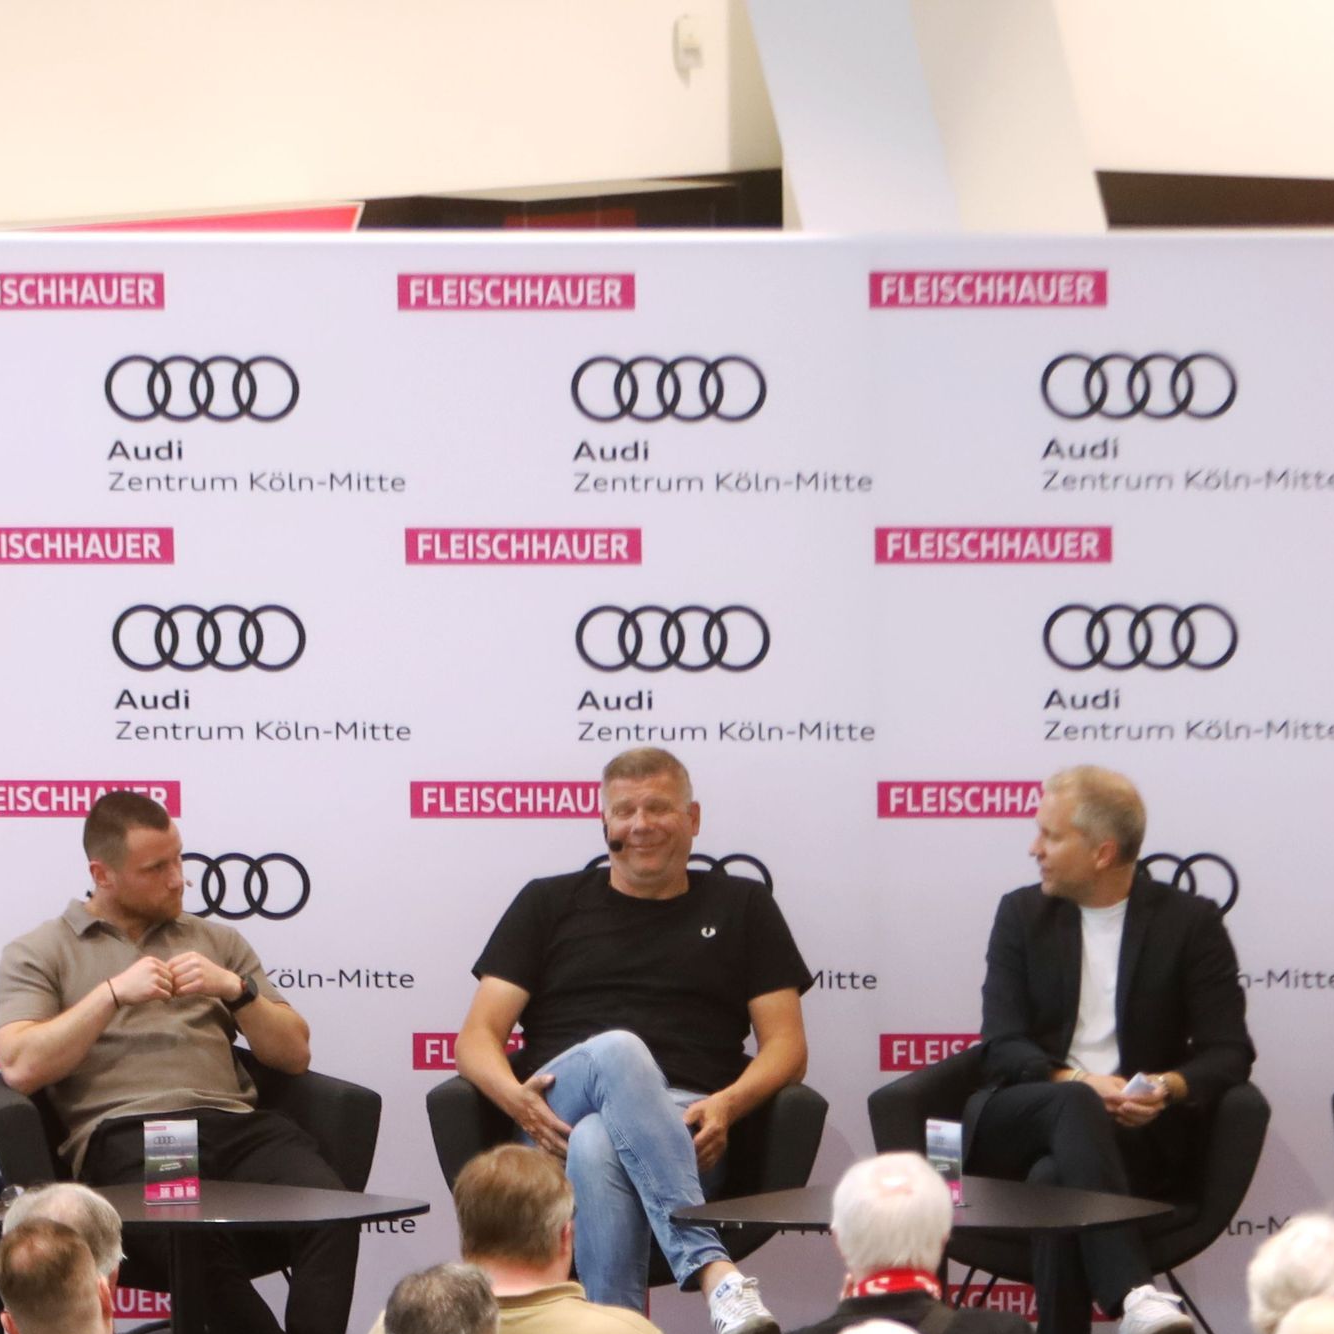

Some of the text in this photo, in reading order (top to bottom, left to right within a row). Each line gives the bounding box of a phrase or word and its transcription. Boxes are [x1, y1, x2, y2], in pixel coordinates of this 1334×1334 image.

[410, 279, 622, 305] FLEISCHHAUER
[881, 276, 1094, 303] FLEISCHHAUER
[108, 440, 183, 461] Audi
[574, 441, 649, 461] Audi
[1043, 438, 1118, 459] Audi
[109, 471, 406, 492] Zentrum Köln-Mitte
[574, 472, 873, 492] Zentrum Köln-Mitte
[1043, 469, 1174, 491] Zentrum
[417, 533, 628, 559] FLEISCHHAUER
[887, 532, 1098, 558] FLEISCHHAUER
[115, 689, 190, 710] Audi
[578, 690, 653, 711] Audi
[1044, 689, 1120, 709] Audi
[116, 721, 412, 741] Zentrum Köln-Mitte
[578, 721, 875, 741] Zentrum Köln-Mitte
[1045, 720, 1175, 740] Zentrum
[422, 786, 603, 813] FLEISCHHAU
[889, 786, 1043, 813] FLEISCHHA
